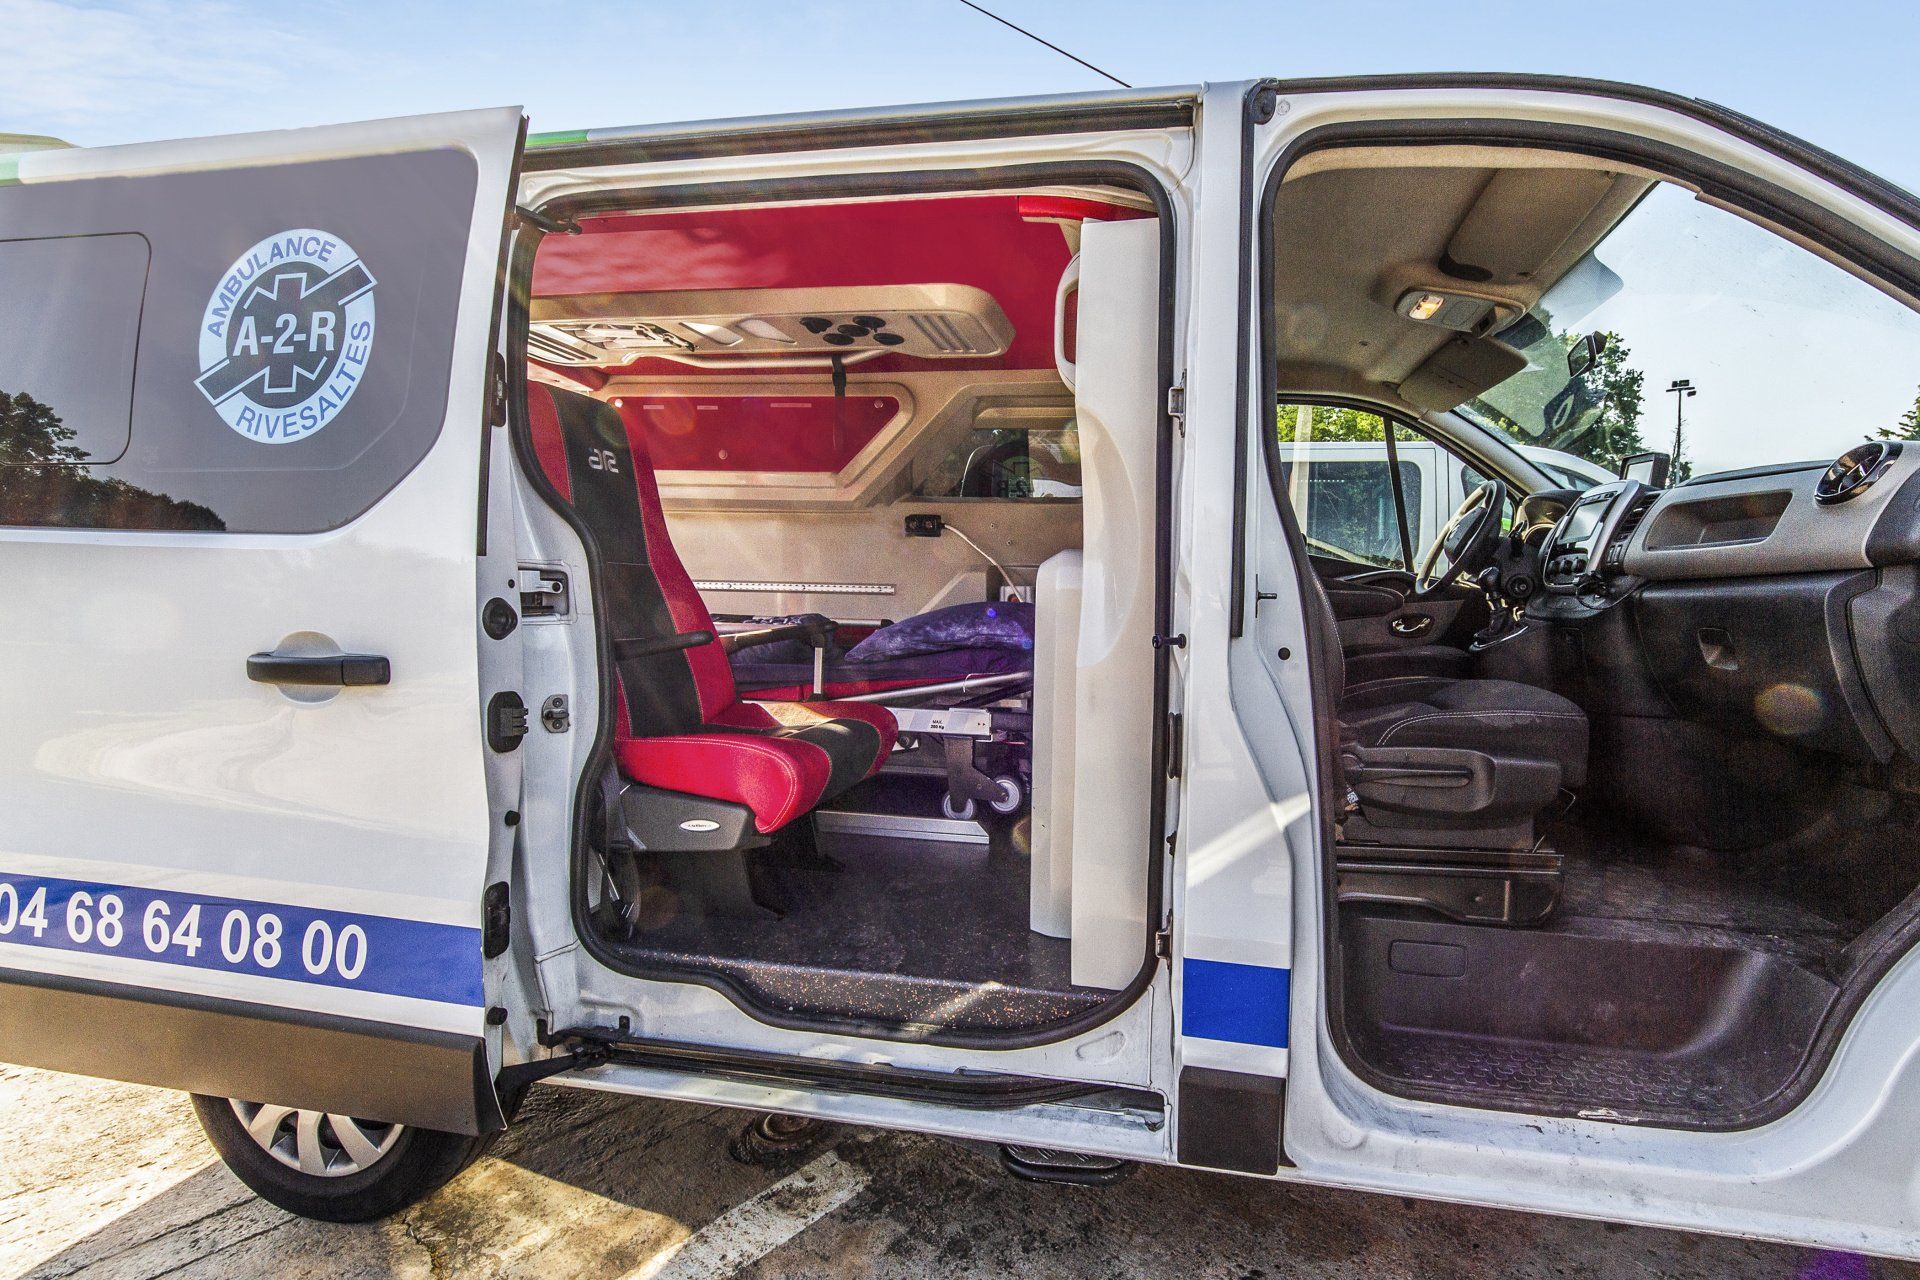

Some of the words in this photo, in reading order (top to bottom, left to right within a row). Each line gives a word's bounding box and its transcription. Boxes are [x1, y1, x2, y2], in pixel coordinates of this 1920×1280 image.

[207, 236, 337, 338] AMBULANCE
[232, 310, 336, 357] A-2-R
[235, 320, 371, 439] RIVESALTES
[0, 883, 48, 938] 04
[66, 891, 124, 947] 68
[142, 900, 202, 957] 64
[220, 910, 282, 968] 08
[302, 920, 368, 980] 00
